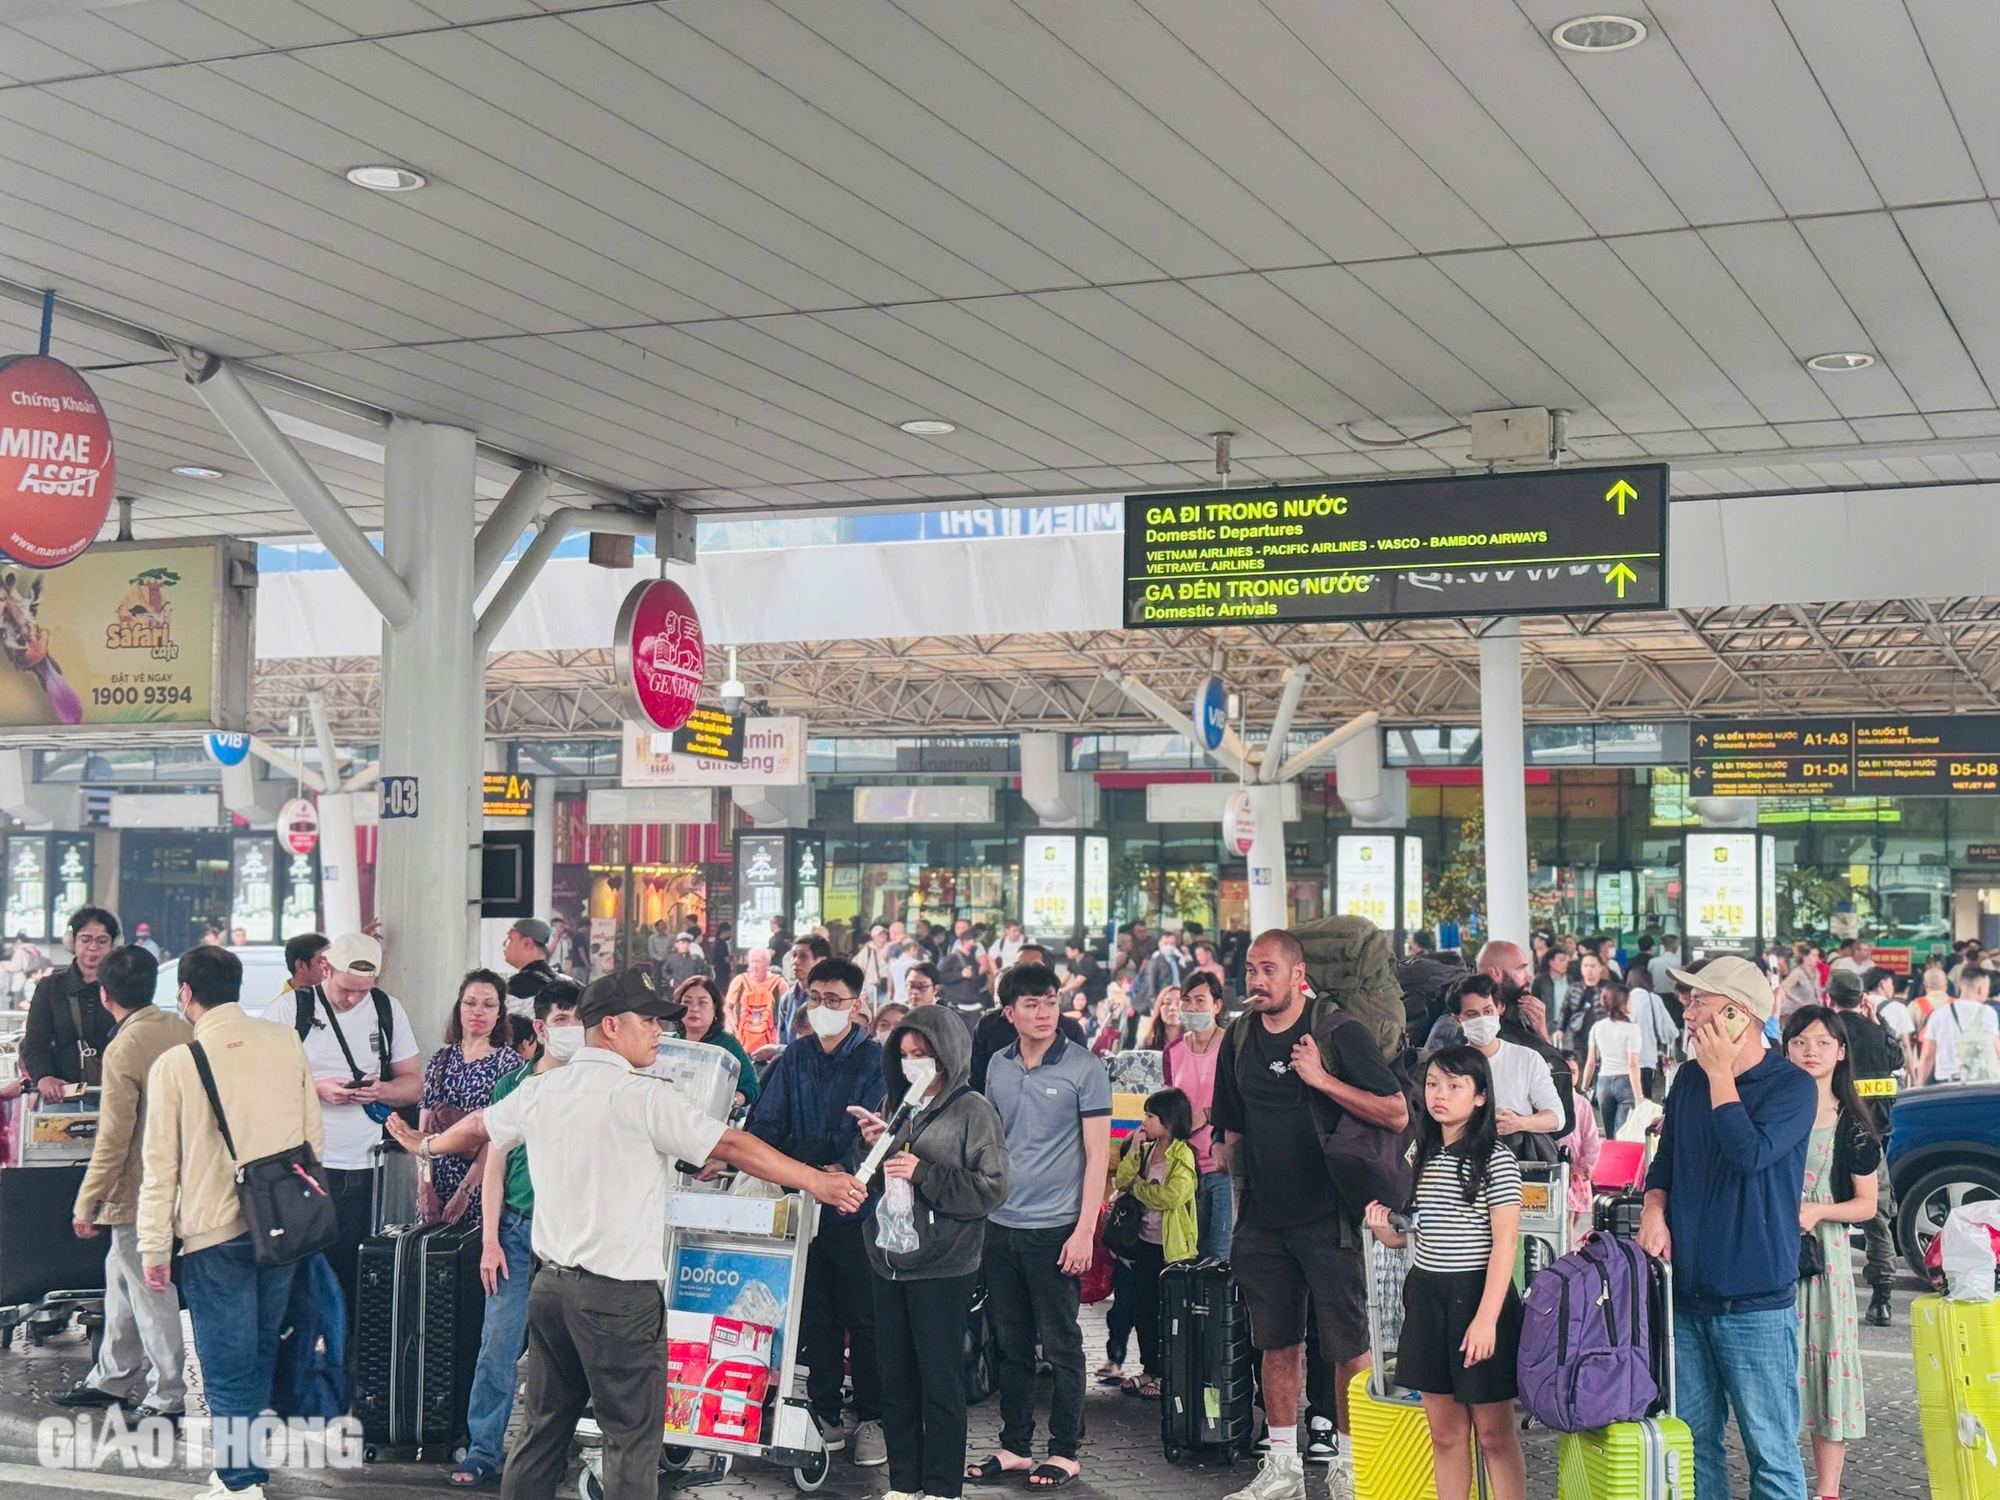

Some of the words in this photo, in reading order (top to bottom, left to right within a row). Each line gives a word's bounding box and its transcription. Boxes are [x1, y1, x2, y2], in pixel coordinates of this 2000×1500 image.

[11, 391, 61, 413] Chứng
[61, 395, 98, 414] Khoán
[0, 427, 91, 464] MIRAE
[17, 462, 100, 498] ASSET
[1145, 506, 1177, 525] GA
[1179, 504, 1201, 524] ĐI
[1204, 501, 1279, 523] TRONG
[1283, 494, 1349, 517] NƯỚC
[1145, 526, 1217, 544] Domestic
[1219, 522, 1304, 541] Departures
[10, 531, 87, 557] www.masvn.com
[1146, 548, 1198, 562] VIETNAM
[1199, 546, 1254, 560] AIRLINES
[1263, 543, 1310, 557] PACIFIC
[1311, 540, 1368, 555] AIRLINES
[1377, 538, 1421, 551] VASCO
[1430, 534, 1487, 548] BAMBOO
[1489, 531, 1549, 545] AIRWAYS
[1146, 561, 1209, 575] VIETRAVEL
[1211, 559, 1266, 572] AIRLINES
[1144, 583, 1176, 602] GA
[1226, 577, 1300, 598] TRONG
[1304, 572, 1371, 595] NƯỚC
[1144, 602, 1216, 620] Domestic
[1217, 600, 1278, 617] Arrivals
[107, 622, 170, 649] Safari
[147, 673, 174, 684] NGAY
[92, 686, 139, 706] 1900
[144, 686, 193, 705] 9394
[1208, 705, 1226, 729] VIB
[1745, 732, 1773, 740] TRONG
[1803, 732, 1849, 746] A1-A3
[1857, 728, 1870, 736] GA
[1857, 737, 1905, 745] International
[1906, 736, 1940, 744] Terminal
[1735, 761, 1764, 769] TRONG
[1802, 763, 1849, 777] D1-D4
[1857, 760, 1871, 768] GA
[1882, 760, 1912, 768] TRONG
[1857, 769, 1893, 777] Domestic
[1893, 769, 1936, 778] Departures
[1949, 763, 1999, 776] D5-D8
[505, 775, 521, 799] A
[1952, 781, 1982, 789] VIETJET
[1983, 781, 1997, 789] AIR
[680, 1266, 740, 1287] DORCO
